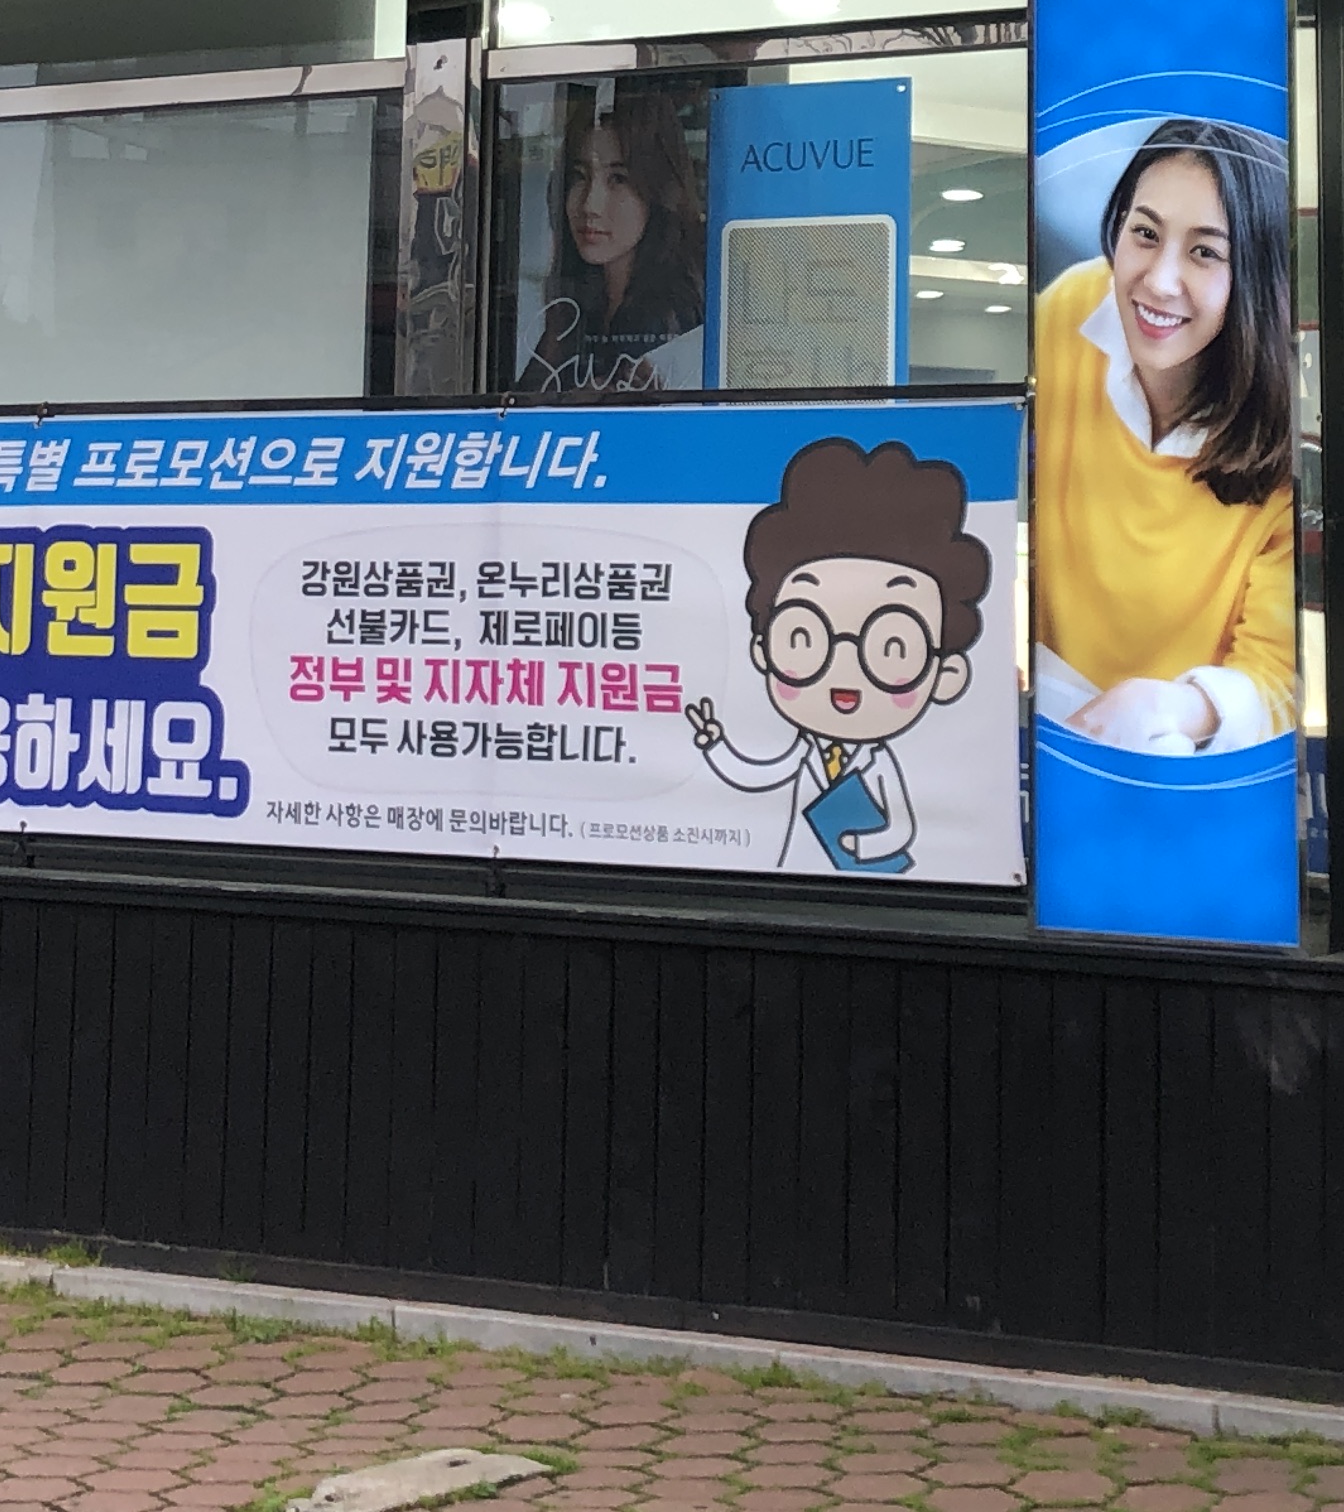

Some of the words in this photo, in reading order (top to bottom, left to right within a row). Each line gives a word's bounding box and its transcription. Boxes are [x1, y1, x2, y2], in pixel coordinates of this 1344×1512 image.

[740, 138, 874, 173] ACUVUE
[73, 436, 344, 490] 프로모션으로
[354, 430, 608, 490] 지원합니다.
[300, 559, 468, 602] 강원상품권,
[476, 560, 674, 602] 온누리상품권
[326, 608, 462, 651] 선불카드,
[479, 610, 642, 650] 제로페이등
[289, 654, 366, 704] 정부
[375, 656, 414, 706] 및
[424, 658, 545, 708] 지자체
[557, 662, 683, 714] 지원금
[327, 717, 388, 755] 모두
[396, 718, 637, 765] 사용가능합니다.
[266, 800, 321, 826] 자세한
[326, 803, 381, 830] 사항은
[387, 805, 444, 833] 매장에
[448, 807, 573, 840] 문의바랍니다.
